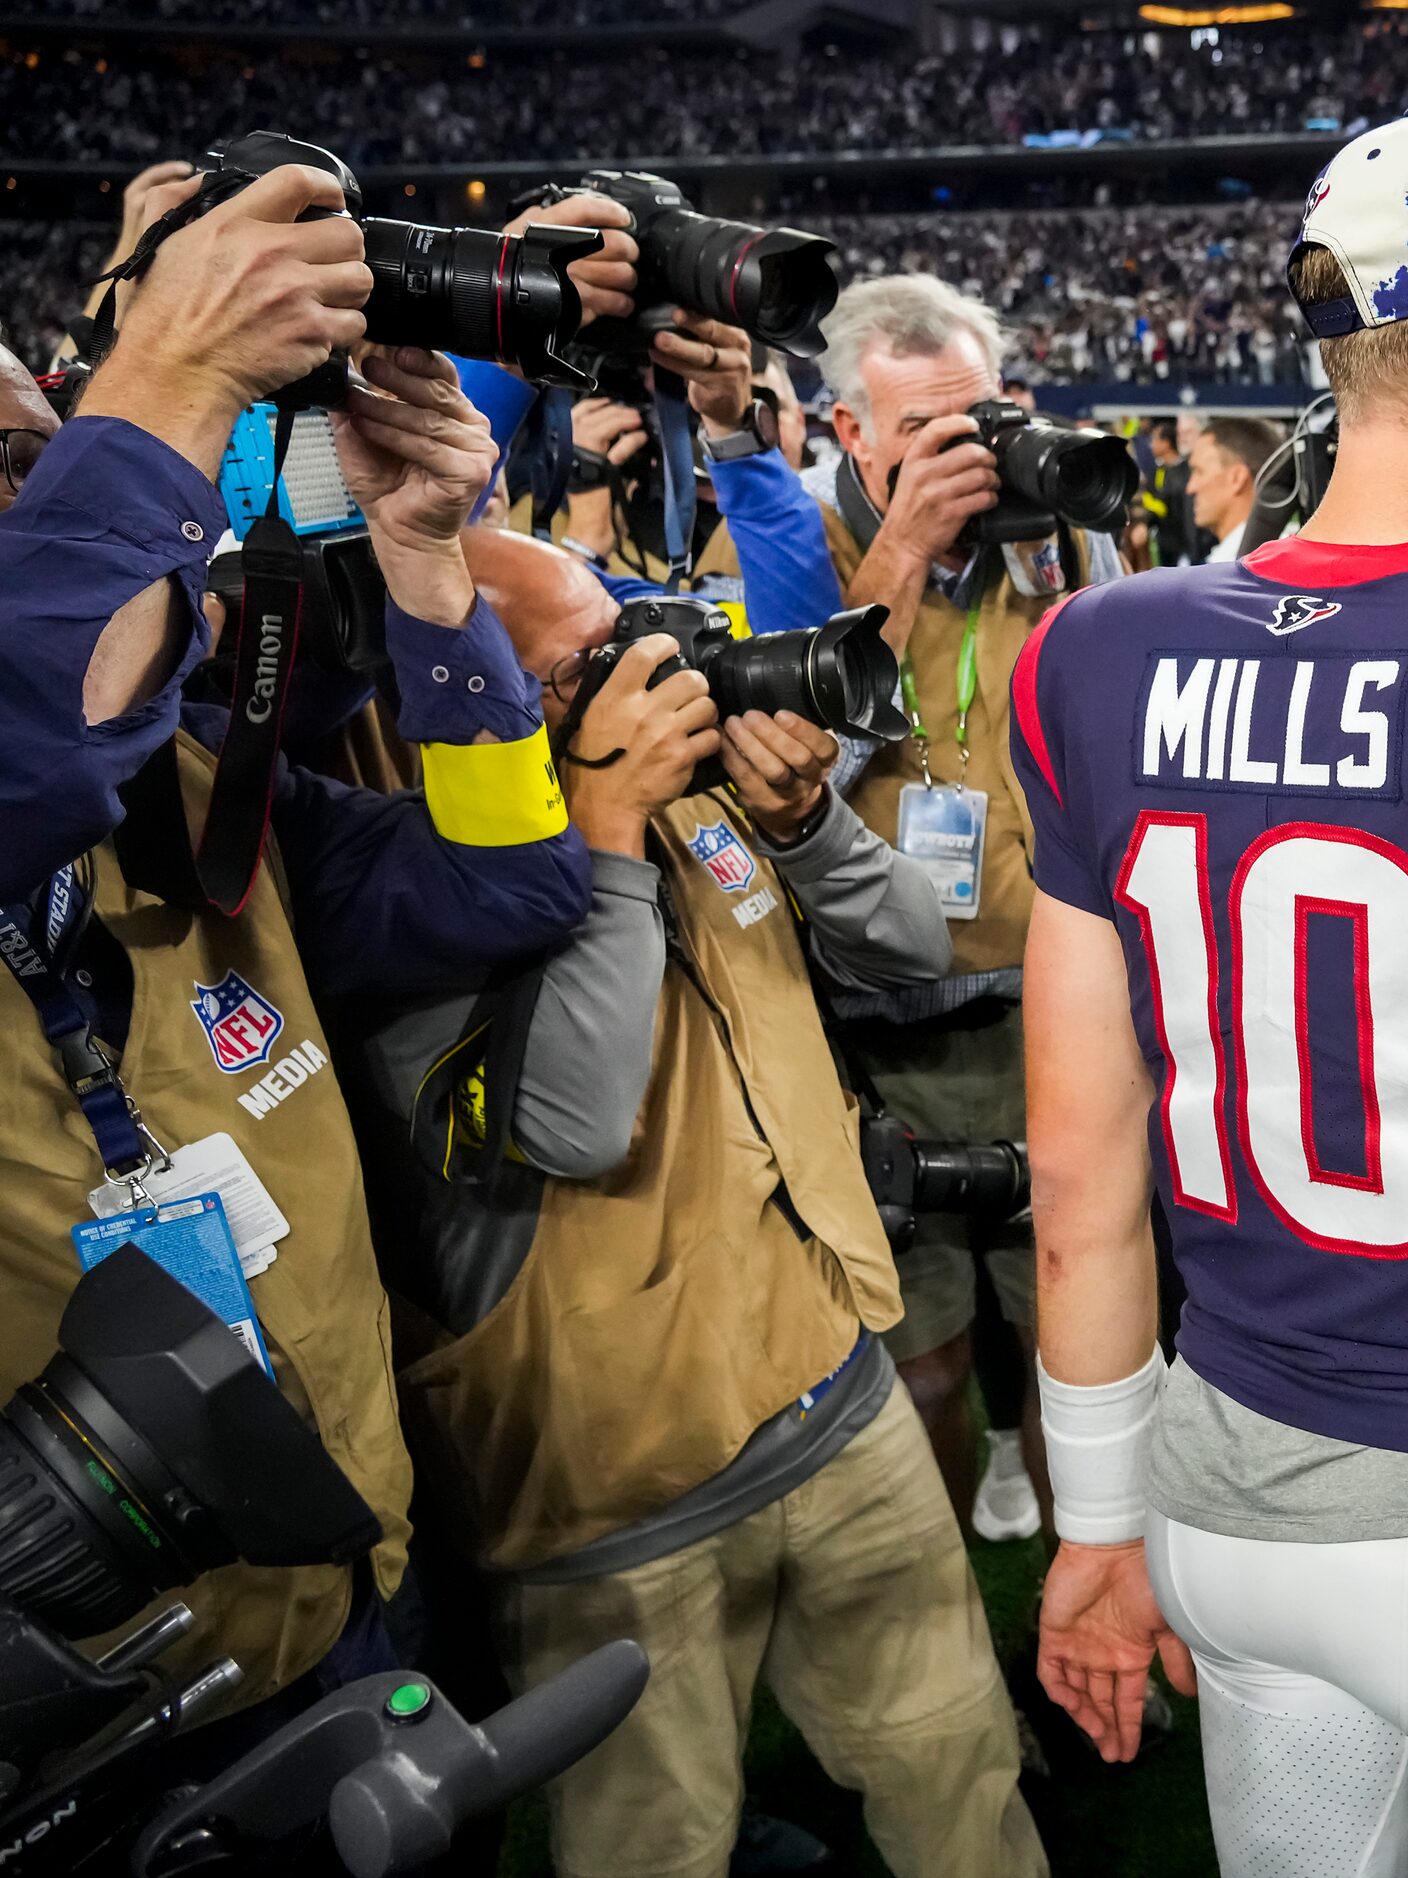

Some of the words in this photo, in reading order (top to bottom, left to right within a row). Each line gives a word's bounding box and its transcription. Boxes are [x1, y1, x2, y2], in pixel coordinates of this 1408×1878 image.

[245, 614, 283, 724] Canon
[1142, 656, 1401, 790] MILLS
[706, 847, 750, 885] NFL
[213, 1004, 275, 1065] NFL
[236, 1038, 328, 1121] MEDIA
